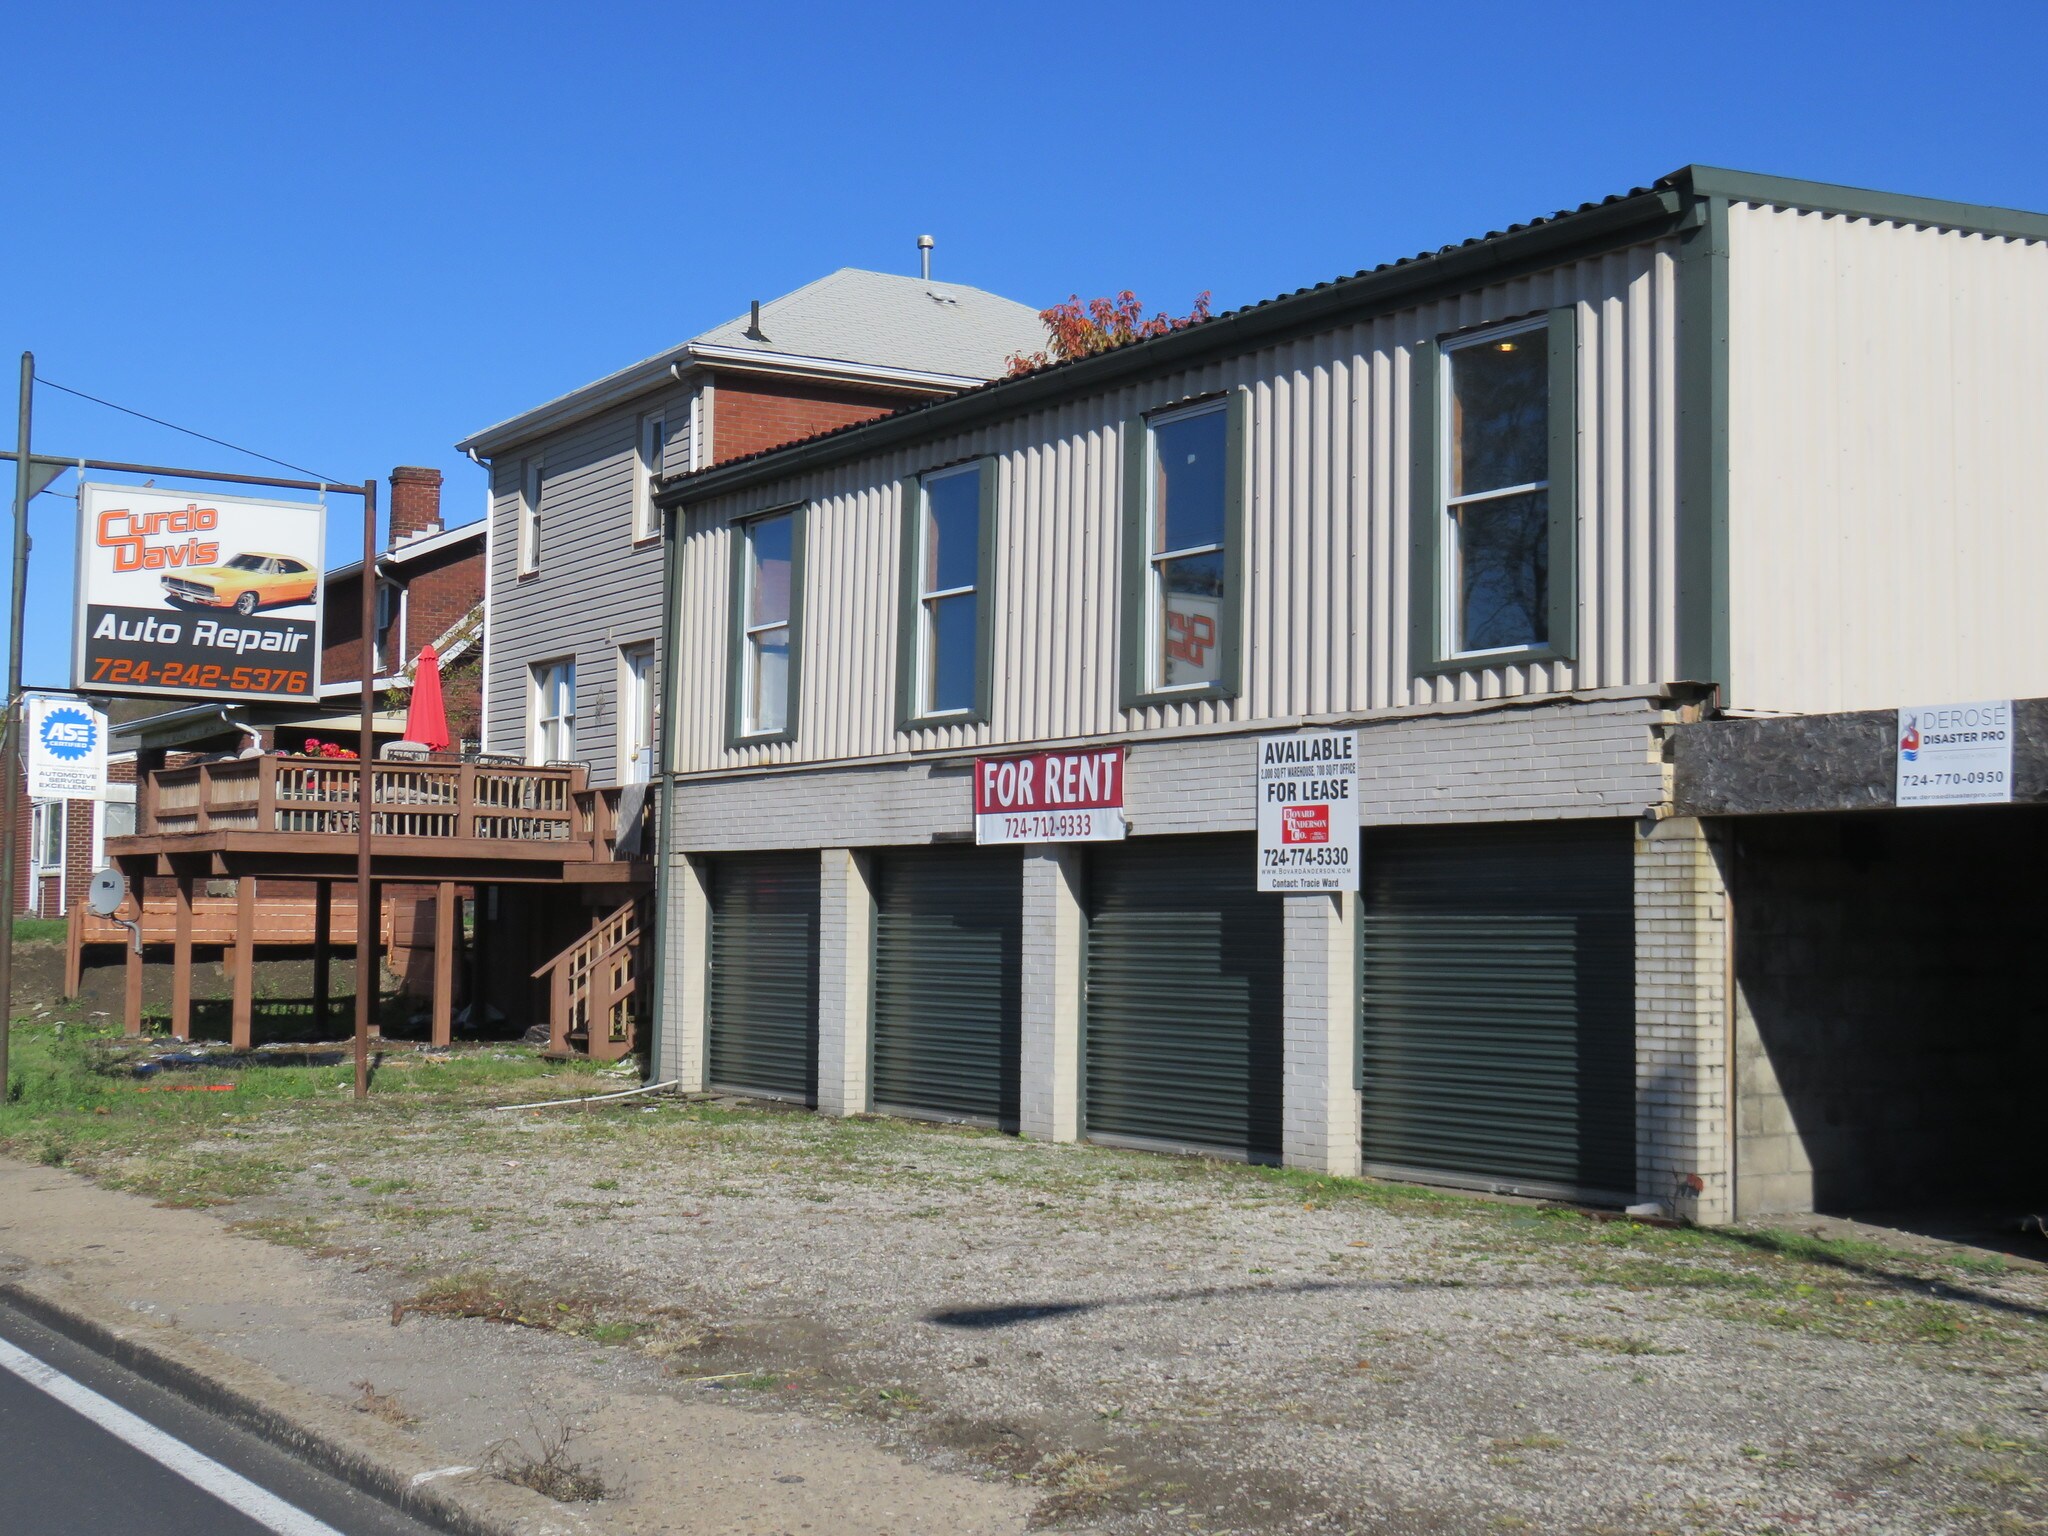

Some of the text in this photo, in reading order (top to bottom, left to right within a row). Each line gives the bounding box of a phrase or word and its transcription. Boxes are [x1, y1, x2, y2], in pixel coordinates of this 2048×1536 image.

[96, 504, 218, 547] Curcio
[113, 535, 219, 573] Davis
[93, 613, 308, 655] Auto Repair
[92, 658, 308, 692] 724-242-5376
[1923, 707, 2006, 730] DEROSE
[46, 722, 89, 742] ASE
[1923, 731, 2005, 745] DISASTER PRO
[49, 741, 88, 749] CERTIFIED
[1265, 737, 1352, 764] AVAILABLE
[39, 771, 97, 780] AUTOMOTIVE
[1340, 762, 1356, 774] OFFICE
[39, 783, 97, 791] EXCELLENCE
[49, 777, 87, 785] SERVICE
[984, 753, 1117, 807] FOR RENT
[1902, 771, 2004, 786] 724-770-0950
[1268, 779, 1348, 802] FOR LEASE
[1901, 792, 2004, 800] www.derosedisasterpro.com
[1005, 814, 1091, 839] 724-712-9333
[1264, 847, 1348, 866] 724-774-5330
[1272, 878, 1339, 888] Contact: Tracie Ward
